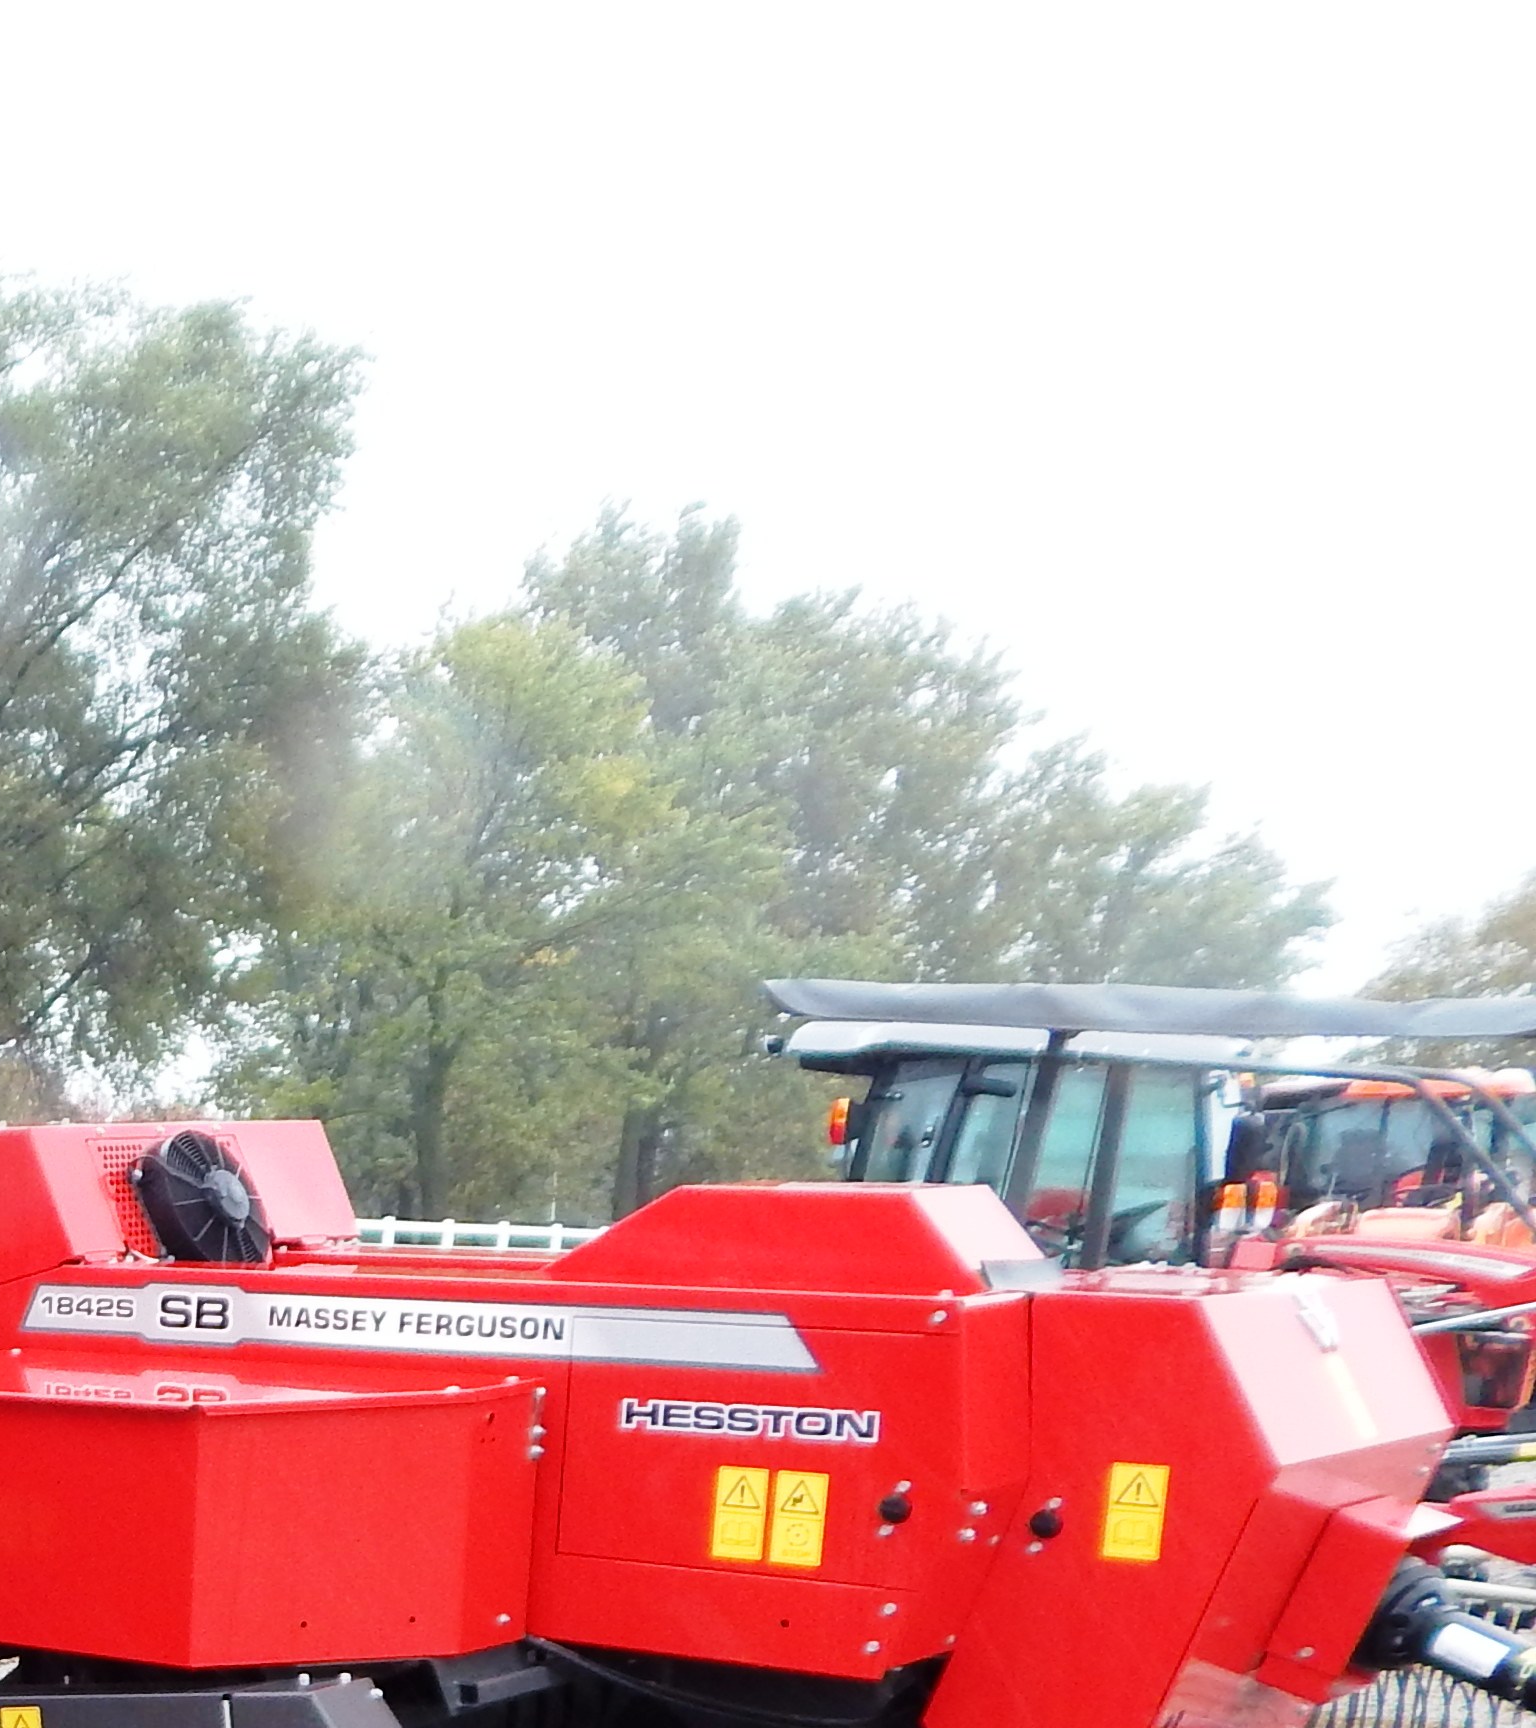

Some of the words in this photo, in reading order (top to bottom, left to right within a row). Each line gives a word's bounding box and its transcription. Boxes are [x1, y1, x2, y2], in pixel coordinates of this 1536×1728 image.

[159, 1294, 229, 1330] SB
[268, 1305, 387, 1332] MASSEY
[398, 1311, 565, 1341] FERGUSON
[623, 1399, 878, 1440] HESSTON
